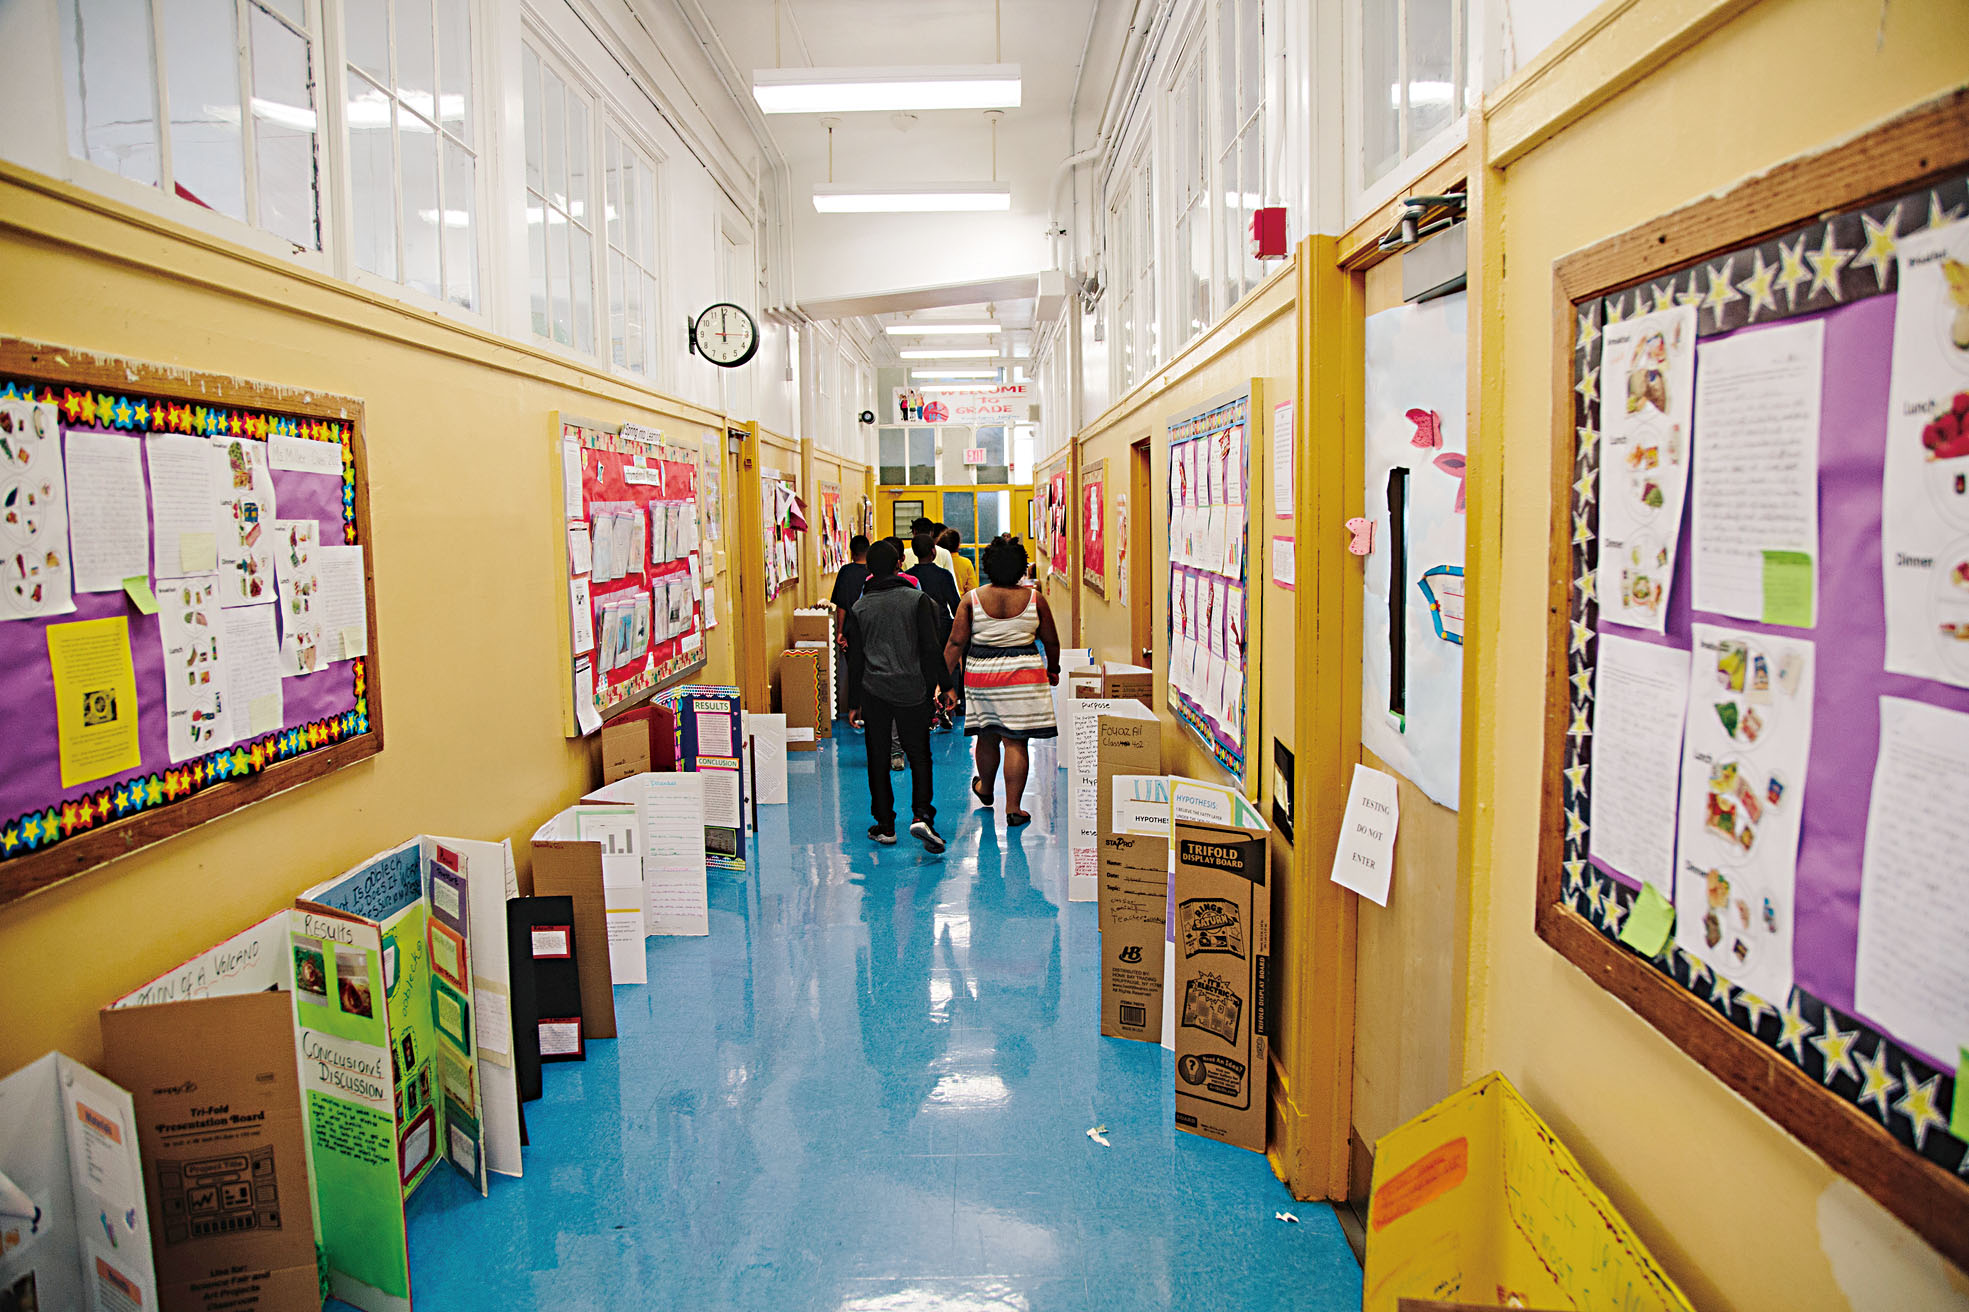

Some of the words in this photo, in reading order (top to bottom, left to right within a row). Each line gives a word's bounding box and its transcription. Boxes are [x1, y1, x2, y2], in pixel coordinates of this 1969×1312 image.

[955, 404, 1014, 414] GRADE
[1904, 400, 1936, 416] Lunch
[967, 450, 984, 462] EXIT
[1897, 552, 1934, 568] Dinner
[695, 702, 728, 710] RESULTS
[1102, 738, 1120, 746] Class
[698, 758, 737, 767] CONCLUSION
[1362, 798, 1390, 815] TESTING
[1356, 824, 1367, 834] DO
[1369, 828, 1383, 841] NOT
[1187, 844, 1238, 860] TRIFOLD
[1182, 853, 1215, 864] DISPLAY
[1216, 858, 1243, 868] BOARD
[1352, 852, 1376, 869] ENTER
[1198, 982, 1230, 997] ELECTRIC
[190, 1104, 229, 1117] Tri-Fold
[155, 1118, 228, 1133] Presentation
[229, 1110, 264, 1124] Board
[190, 1280, 229, 1291] Science
[231, 1276, 249, 1284] Fair
[252, 1271, 270, 1281] and
[220, 1285, 260, 1299] Projects
